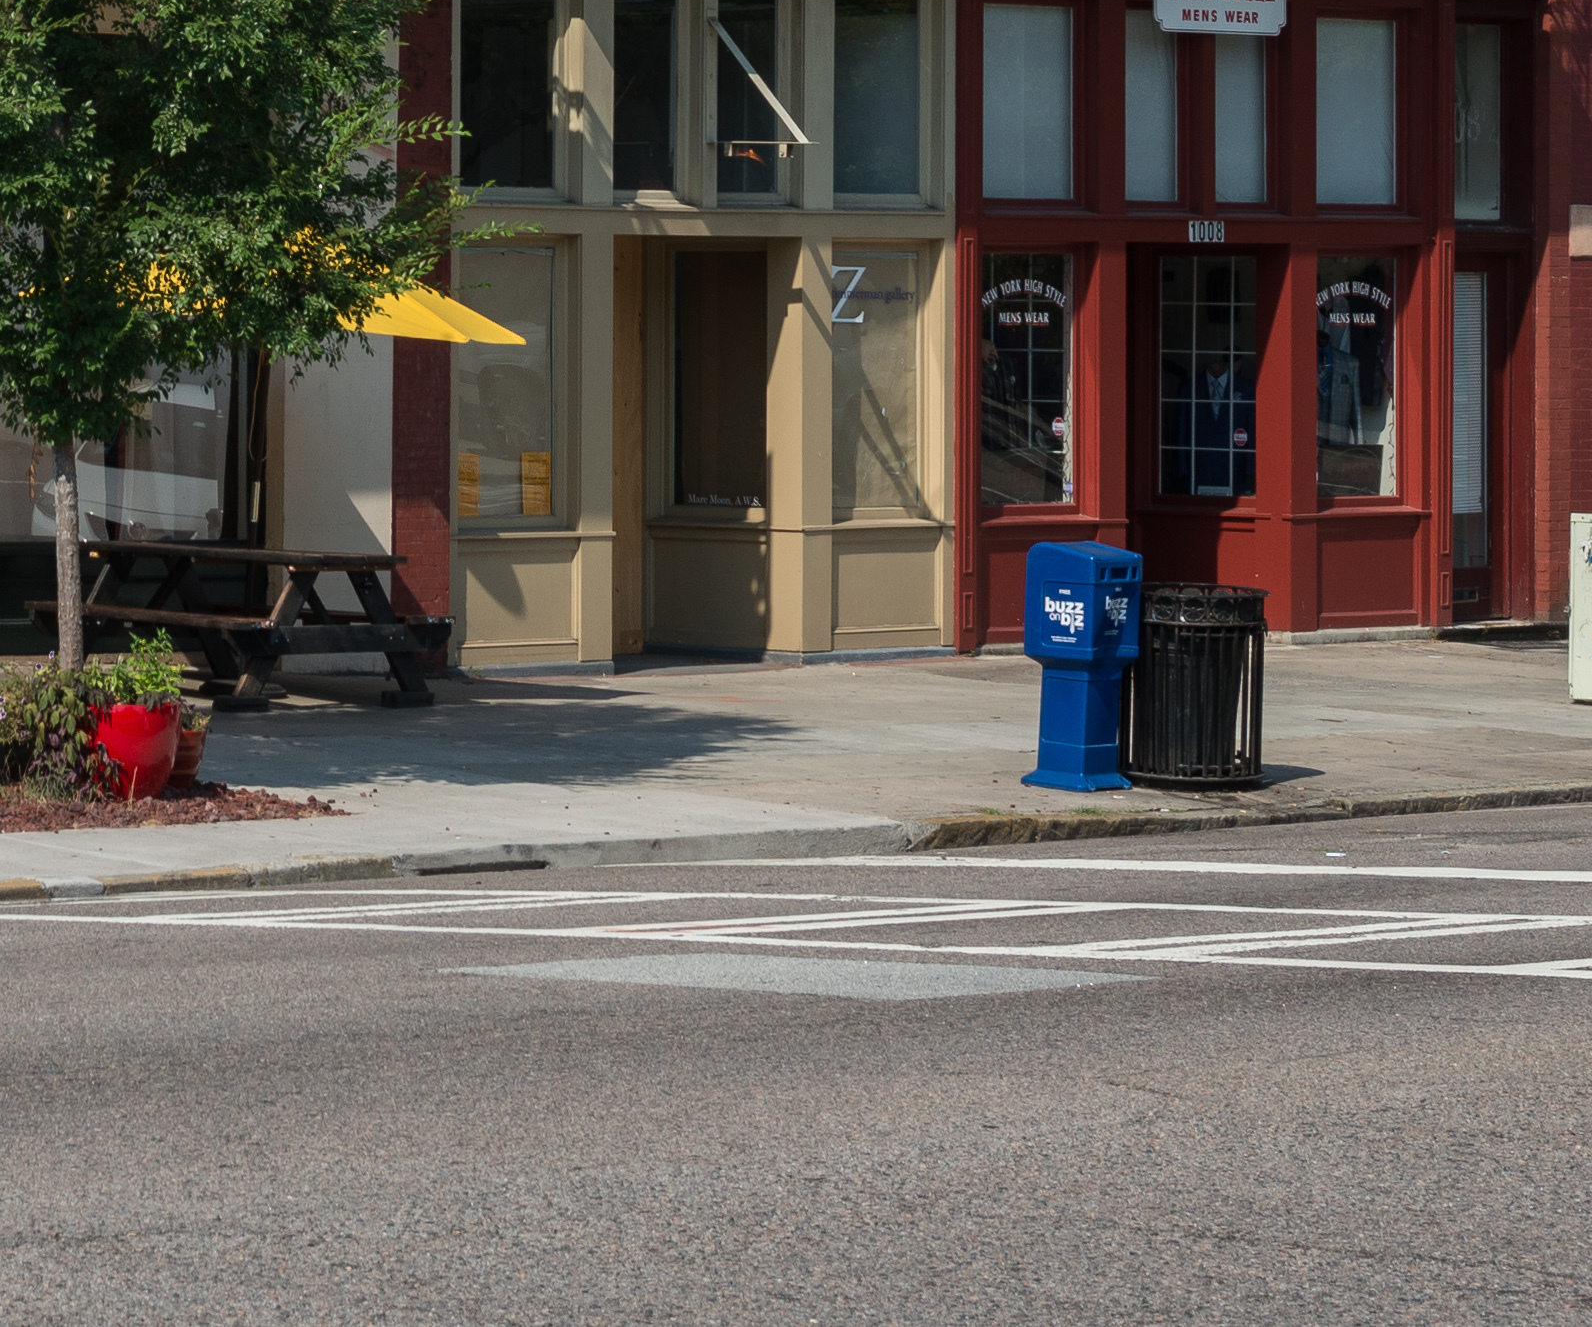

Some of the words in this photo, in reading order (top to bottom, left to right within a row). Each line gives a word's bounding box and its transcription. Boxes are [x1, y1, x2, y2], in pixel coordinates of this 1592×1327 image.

[1181, 8, 1218, 23] MENS
[1224, 10, 1259, 24] WEAR
[1190, 221, 1223, 242] 1008
[831, 265, 867, 324] Z
[981, 286, 999, 307] NEW
[999, 279, 1022, 296] YORK
[1024, 278, 1044, 294] HIGH
[1044, 284, 1067, 307] STYLE
[1330, 281, 1350, 297] YORK
[1352, 280, 1370, 296] HIGH
[1371, 286, 1392, 309] STYLE
[999, 311, 1022, 323] MENS
[1024, 311, 1050, 323] WEAR
[1329, 312, 1350, 324] MENS
[1352, 312, 1376, 324] WEAR
[1044, 596, 1085, 615] buzz
[1049, 612, 1061, 621] on
